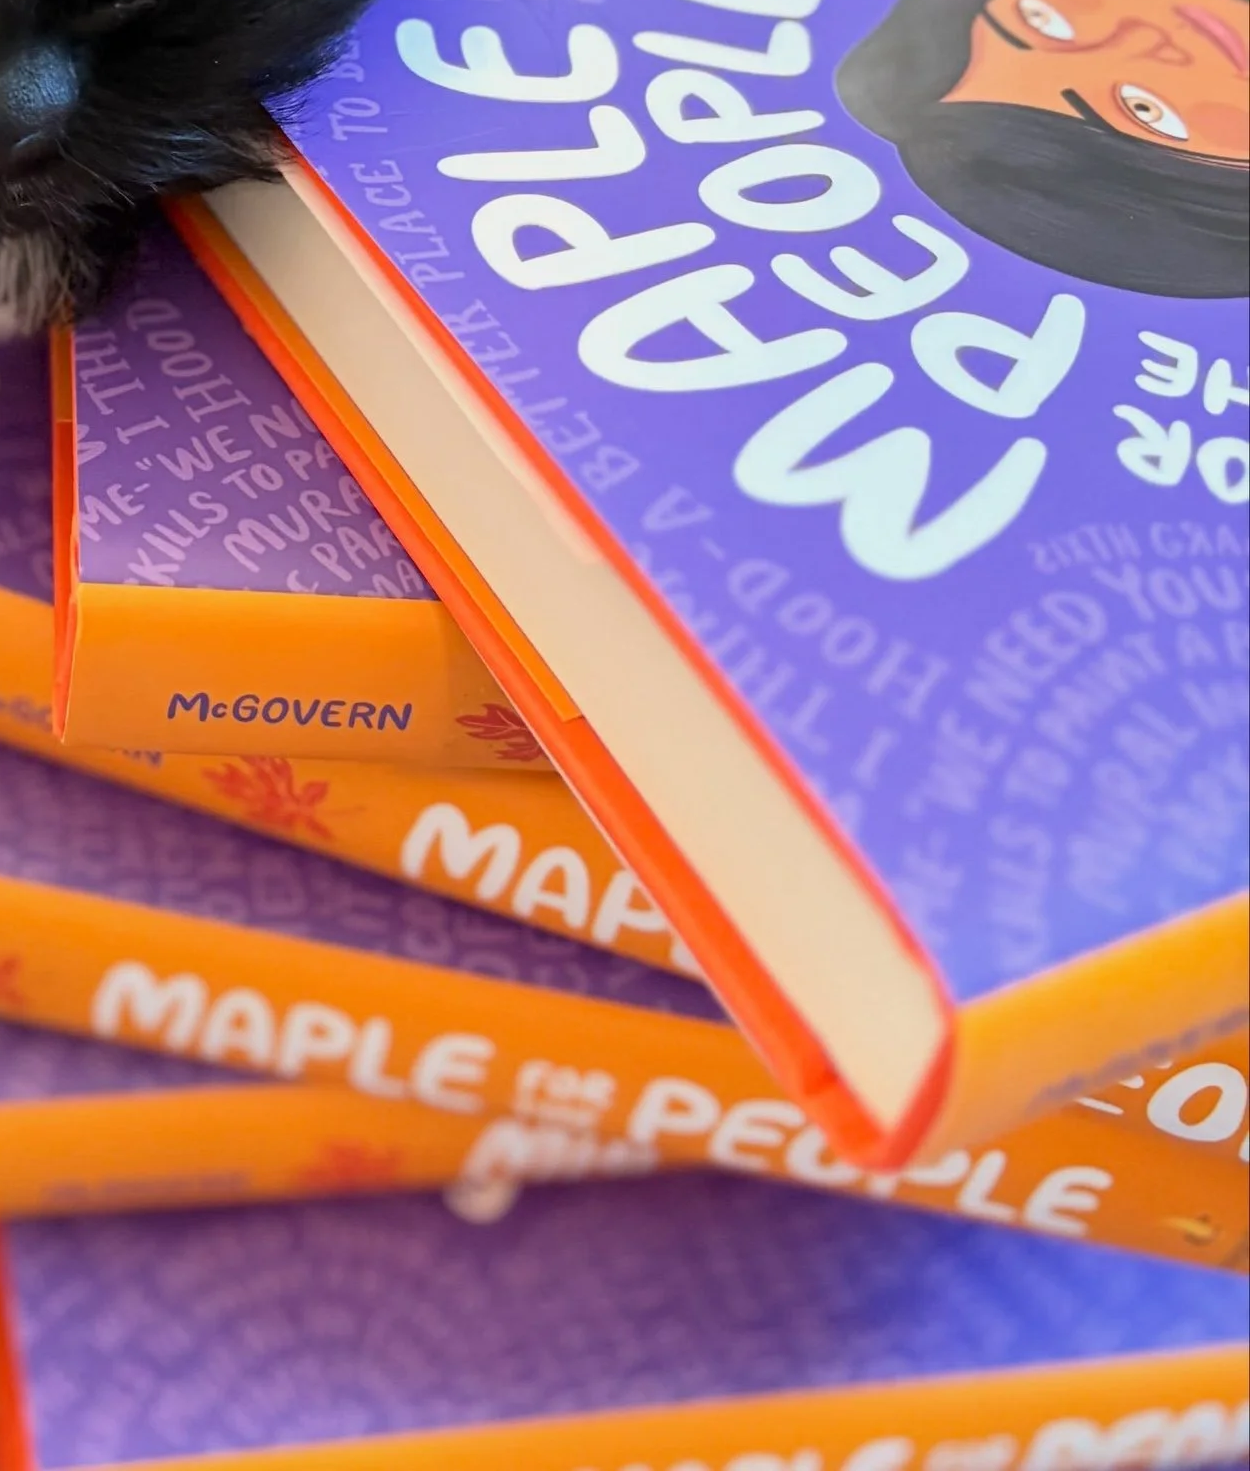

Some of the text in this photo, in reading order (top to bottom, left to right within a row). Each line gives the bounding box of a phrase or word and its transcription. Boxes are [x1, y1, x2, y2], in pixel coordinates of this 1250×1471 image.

[327, 96, 389, 142] TO
[347, 158, 466, 289] PLACE
[124, 297, 252, 423] HOOD
[396, 19, 1047, 581] MAPLE
[442, 297, 641, 493] BETTER
[126, 490, 230, 587] KILLS
[220, 463, 285, 500] TO
[166, 691, 413, 731] McGOVERN
[90, 958, 498, 1116] MAPLE
